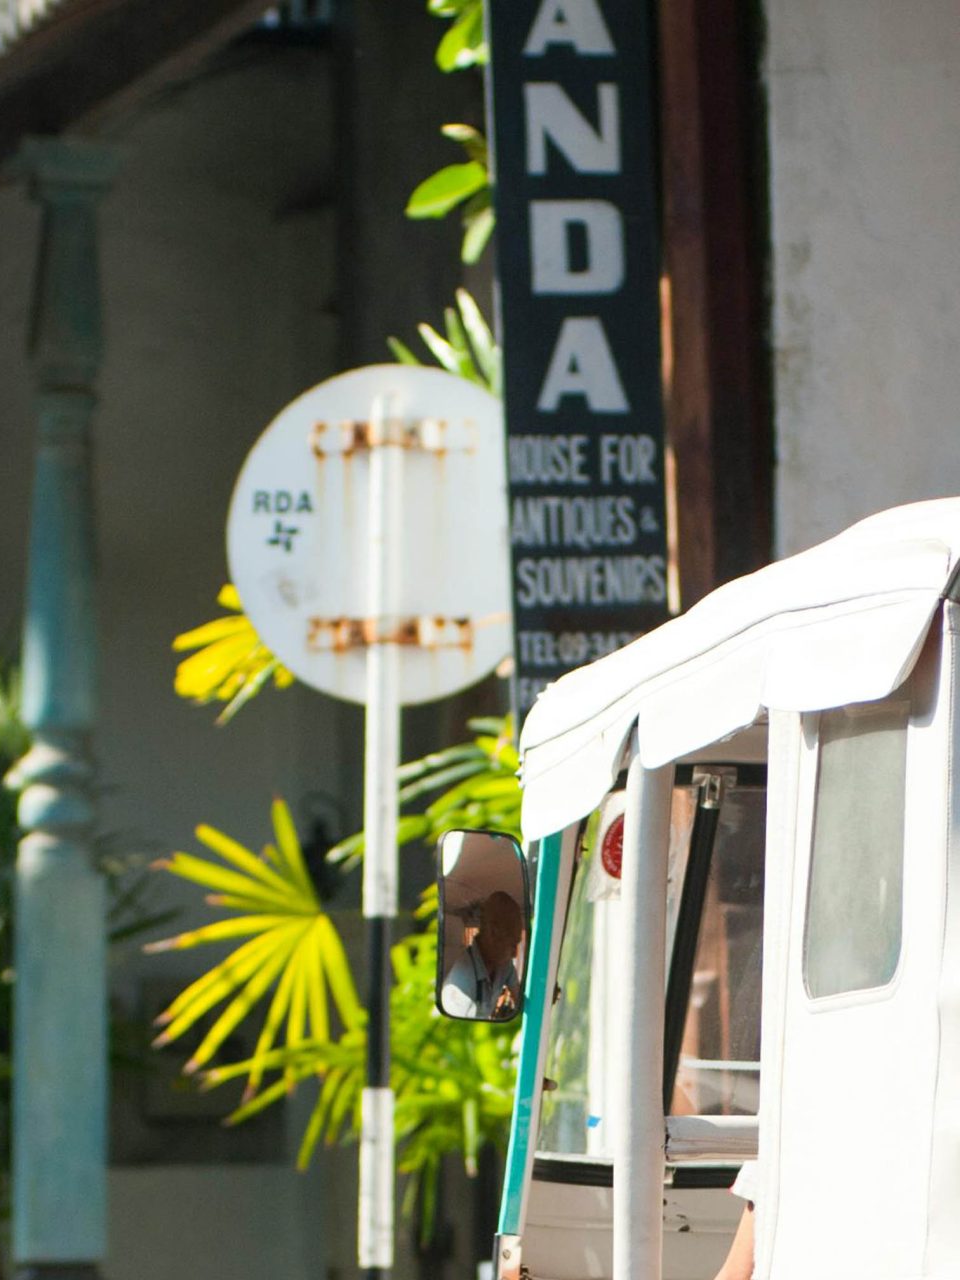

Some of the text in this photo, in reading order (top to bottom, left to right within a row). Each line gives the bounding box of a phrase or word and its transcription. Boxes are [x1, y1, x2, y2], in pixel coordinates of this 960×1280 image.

[600, 434, 657, 484] FOR
[253, 490, 313, 513] RDA
[511, 496, 638, 551] ANTIQUES
[516, 556, 667, 608] SOUVENIRS
